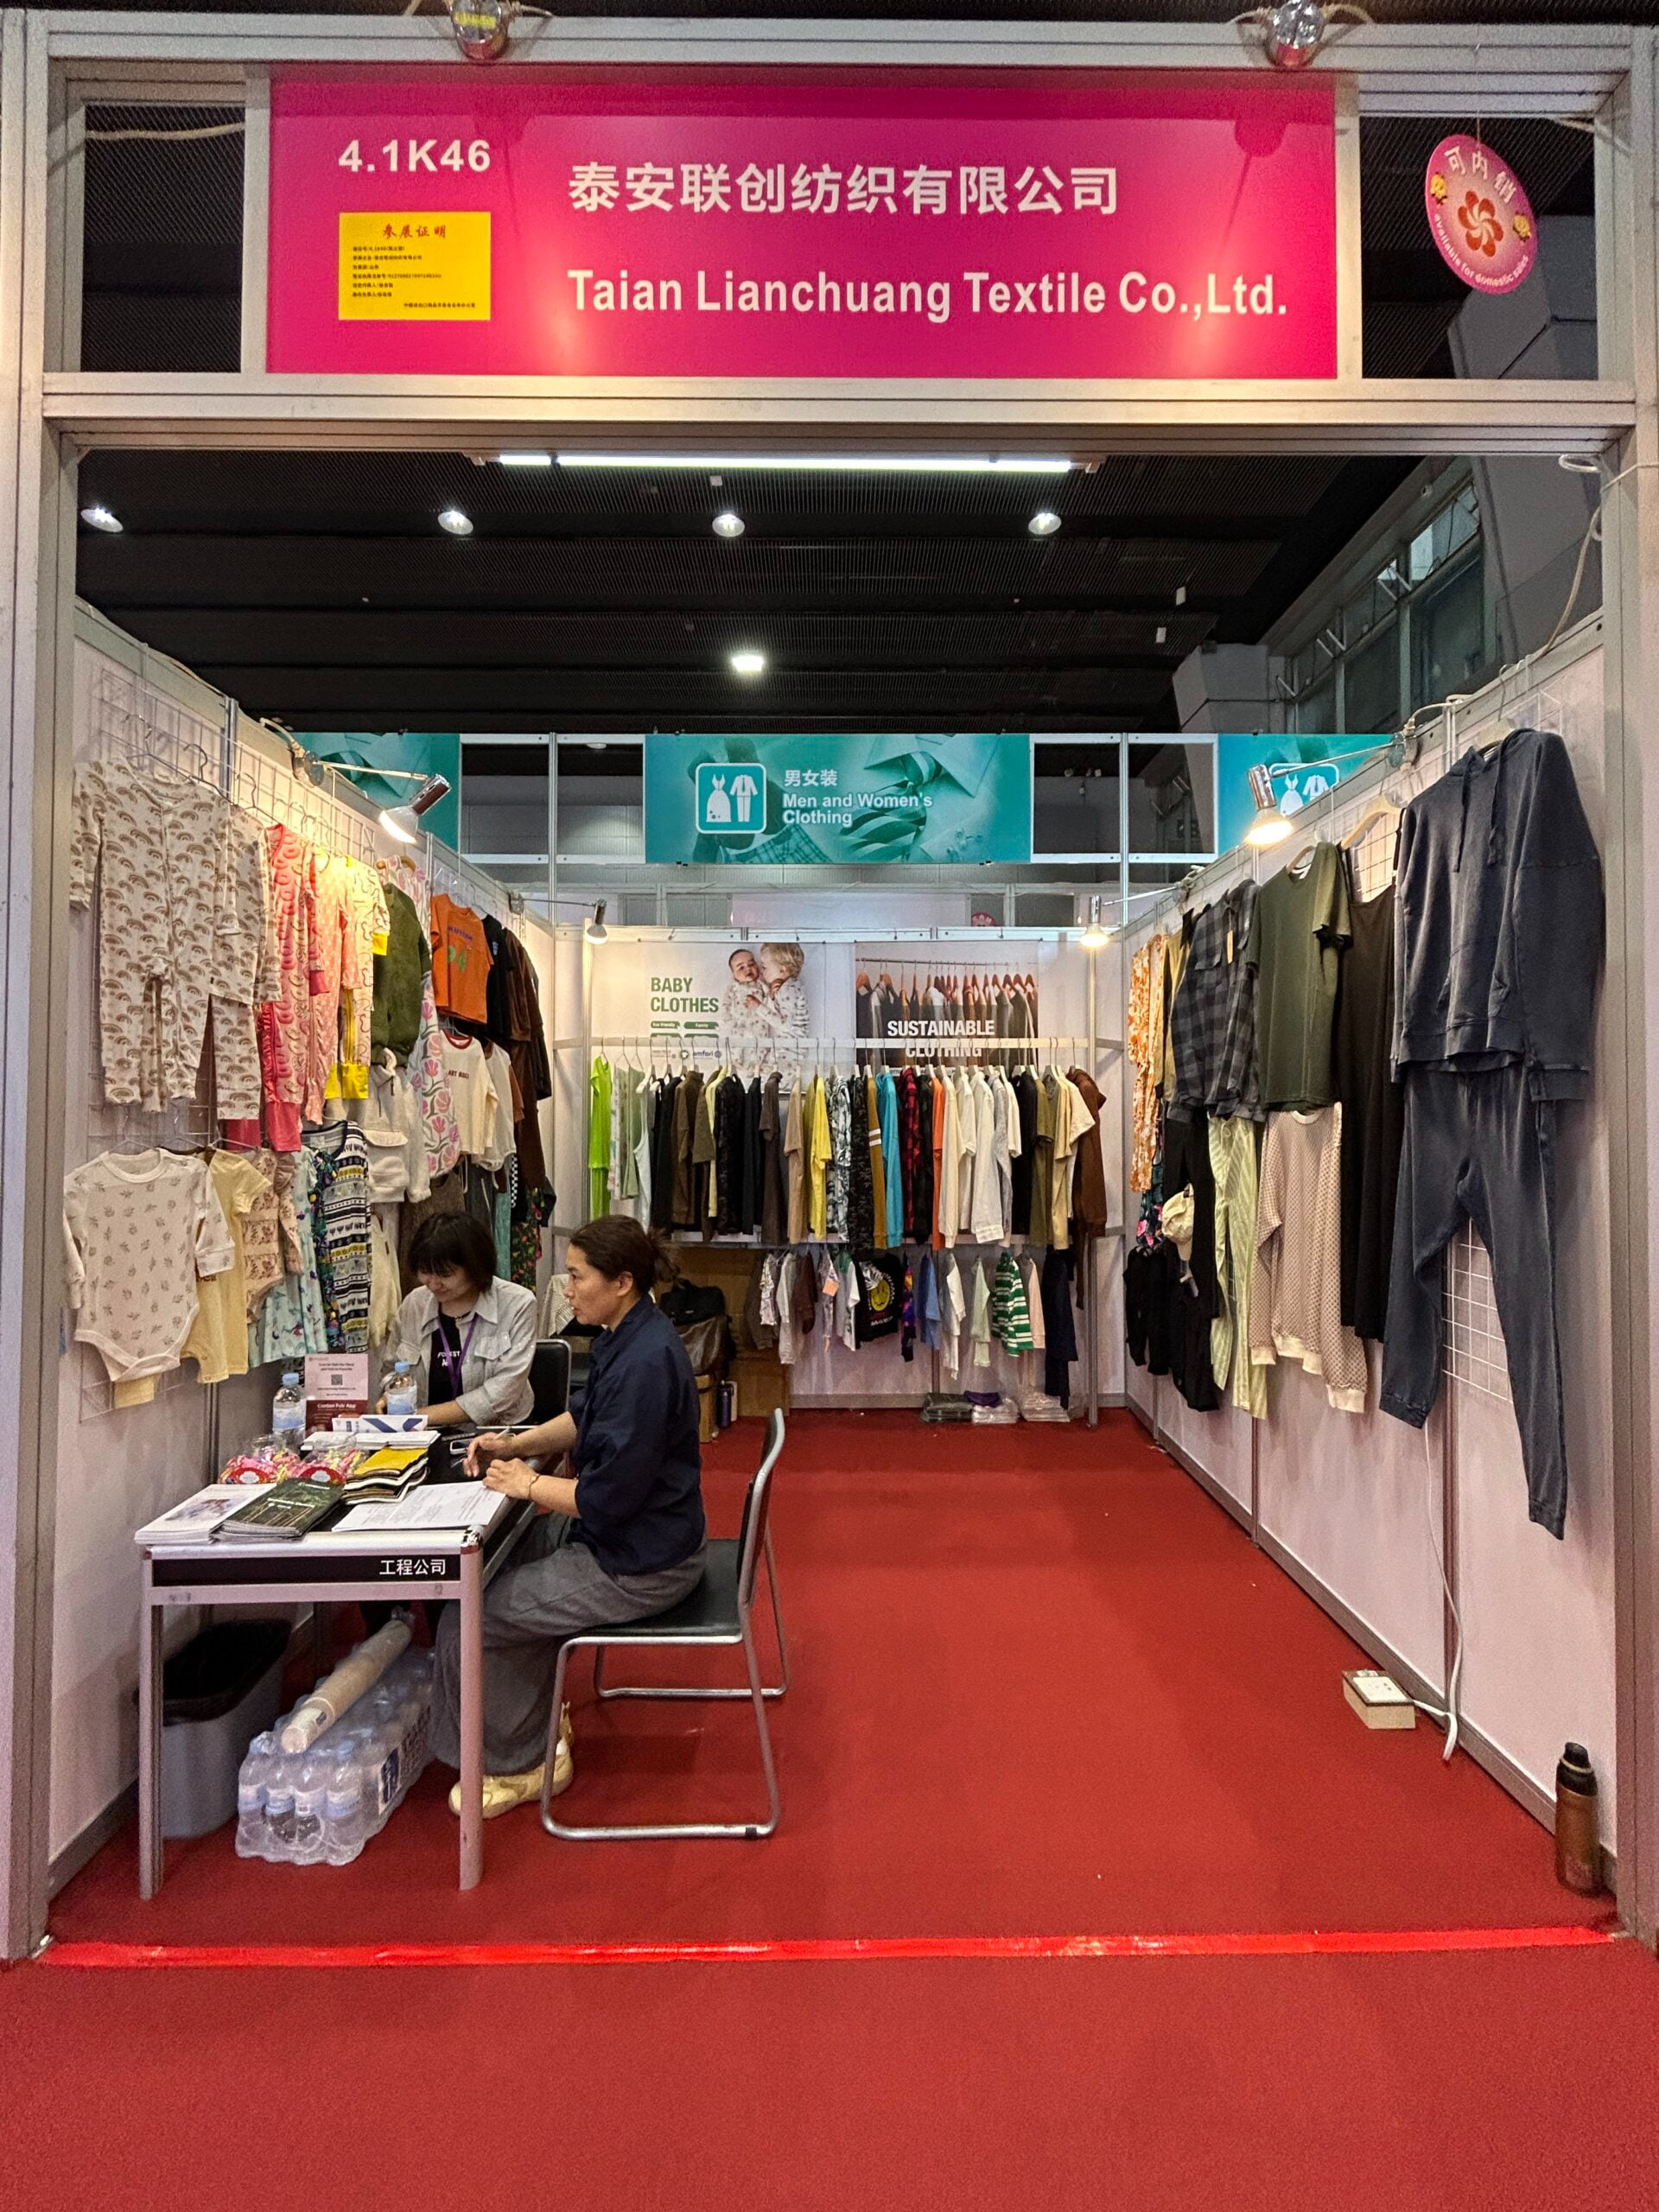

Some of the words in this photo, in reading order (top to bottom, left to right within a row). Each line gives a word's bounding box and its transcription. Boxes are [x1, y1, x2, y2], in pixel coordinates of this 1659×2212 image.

[338, 139, 492, 173] 4.1K46
[568, 162, 1118, 216] 泰安联创纺织有限公司
[383, 223, 447, 240] 参展证明
[567, 269, 683, 311] Taian
[696, 269, 951, 324] Lianchuang
[963, 271, 1106, 314] Textile
[1118, 271, 1288, 321] Co.,Ltd.
[783, 769, 838, 788] 男女装
[782, 792, 817, 808] Men
[822, 792, 853, 808] and
[857, 791, 933, 808] Women's
[782, 809, 854, 826] Clothing
[650, 976, 694, 993] BABY
[650, 996, 720, 1014] CLOTHES
[887, 1020, 995, 1037] SUSTAINABLE
[436, 1351, 461, 1359] FOEST
[378, 1558, 447, 1576] 工程公司
